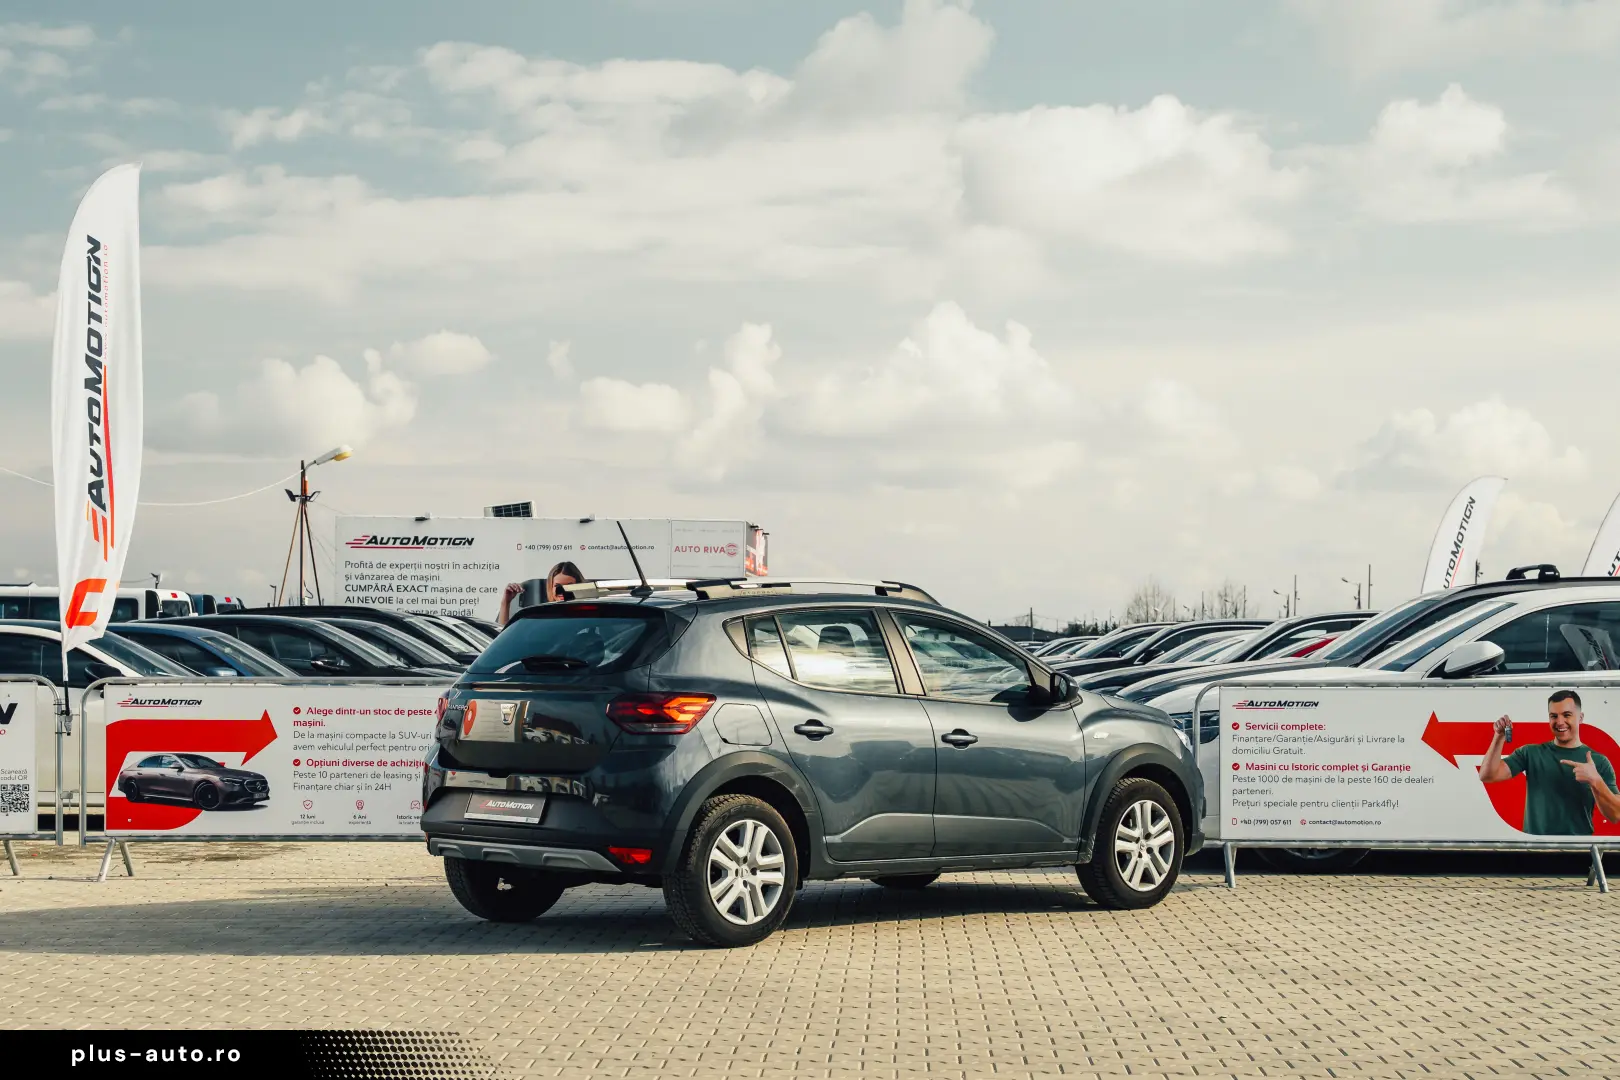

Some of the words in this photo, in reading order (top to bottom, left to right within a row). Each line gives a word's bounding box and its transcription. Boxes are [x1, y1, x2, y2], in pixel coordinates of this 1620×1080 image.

[84, 234, 107, 513] AUTOMOTION
[366, 535, 474, 546] AUTOMOTION
[1443, 496, 1476, 589] UTOMOTION
[344, 560, 373, 569] Profită
[425, 562, 450, 571] noștri
[463, 562, 500, 572] achiziția
[345, 573, 352, 582] și
[355, 573, 394, 581] vânzarea
[397, 573, 408, 581] de
[345, 583, 394, 592] CUMPĂRĂ
[431, 585, 463, 594] mașina
[466, 585, 476, 593] de
[344, 596, 355, 604] AI
[357, 596, 393, 604] NEVOIE
[306, 707, 333, 716] Alege
[335, 707, 371, 715] dintr-un
[408, 708, 432, 717] peste
[293, 719, 326, 728] mașini.
[1245, 722, 1278, 731] Servicii
[1281, 722, 1326, 732] complete:
[293, 731, 305, 739] De
[308, 731, 315, 739] la
[317, 732, 344, 741] mașini
[345, 732, 386, 741] compacte
[389, 731, 396, 739] la
[398, 731, 432, 739] SUV-uri
[1358, 735, 1363, 745] și
[1366, 735, 1395, 743] Livrare
[1398, 735, 1405, 743] la
[317, 743, 354, 751] vehiculul
[356, 743, 386, 752] perfect
[389, 744, 416, 753] pentru
[419, 743, 432, 751] ori
[1232, 746, 1271, 755] domiciliu
[1273, 746, 1305, 755] Gratuit.
[306, 758, 340, 769] Opțiuni
[342, 759, 374, 767] diverse
[377, 759, 388, 767] de
[1245, 763, 1276, 771] Masini
[1292, 763, 1319, 771] Istoric
[1322, 763, 1359, 773] complet
[1362, 763, 1369, 773] și
[1371, 763, 1411, 773] Garanție
[330, 771, 368, 781] parteneri
[370, 771, 381, 779] de
[384, 772, 411, 781] leasing
[414, 772, 421, 781] și
[1232, 775, 1255, 783] Peste
[1258, 775, 1279, 783] 1000
[1281, 775, 1293, 783] de
[1295, 776, 1322, 785] mașini
[1324, 775, 1335, 783] de
[1338, 775, 1345, 783] la
[1347, 776, 1371, 786] peste
[1374, 776, 1388, 784] 160
[1391, 776, 1402, 784] de
[1405, 776, 1434, 784] dealeri
[293, 783, 332, 793] Finanțare
[334, 783, 354, 791] chiar
[356, 783, 363, 793] și
[375, 783, 391, 791] 24H
[1232, 787, 1273, 797] parteneri.
[486, 800, 534, 810] AUTOMOTION
[1232, 799, 1261, 809] Prețuri
[1263, 799, 1297, 810] speciale
[1300, 800, 1328, 810] pentru
[1362, 800, 1399, 810] Park4fly!
